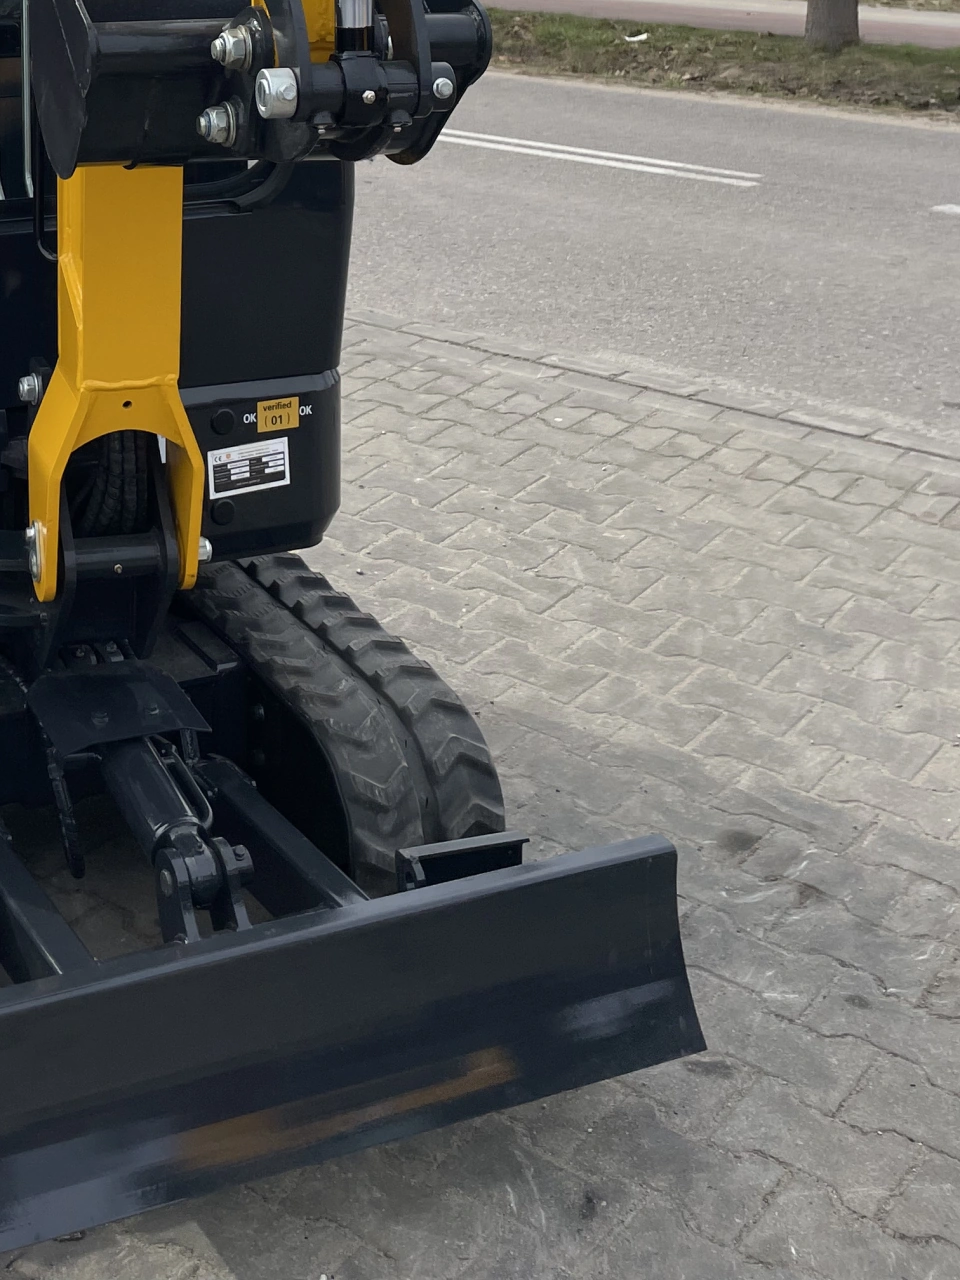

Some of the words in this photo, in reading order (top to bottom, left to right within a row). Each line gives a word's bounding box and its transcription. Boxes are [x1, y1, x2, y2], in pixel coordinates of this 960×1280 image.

[263, 400, 292, 411] verified
[299, 405, 313, 416] OK
[243, 413, 257, 423] OK
